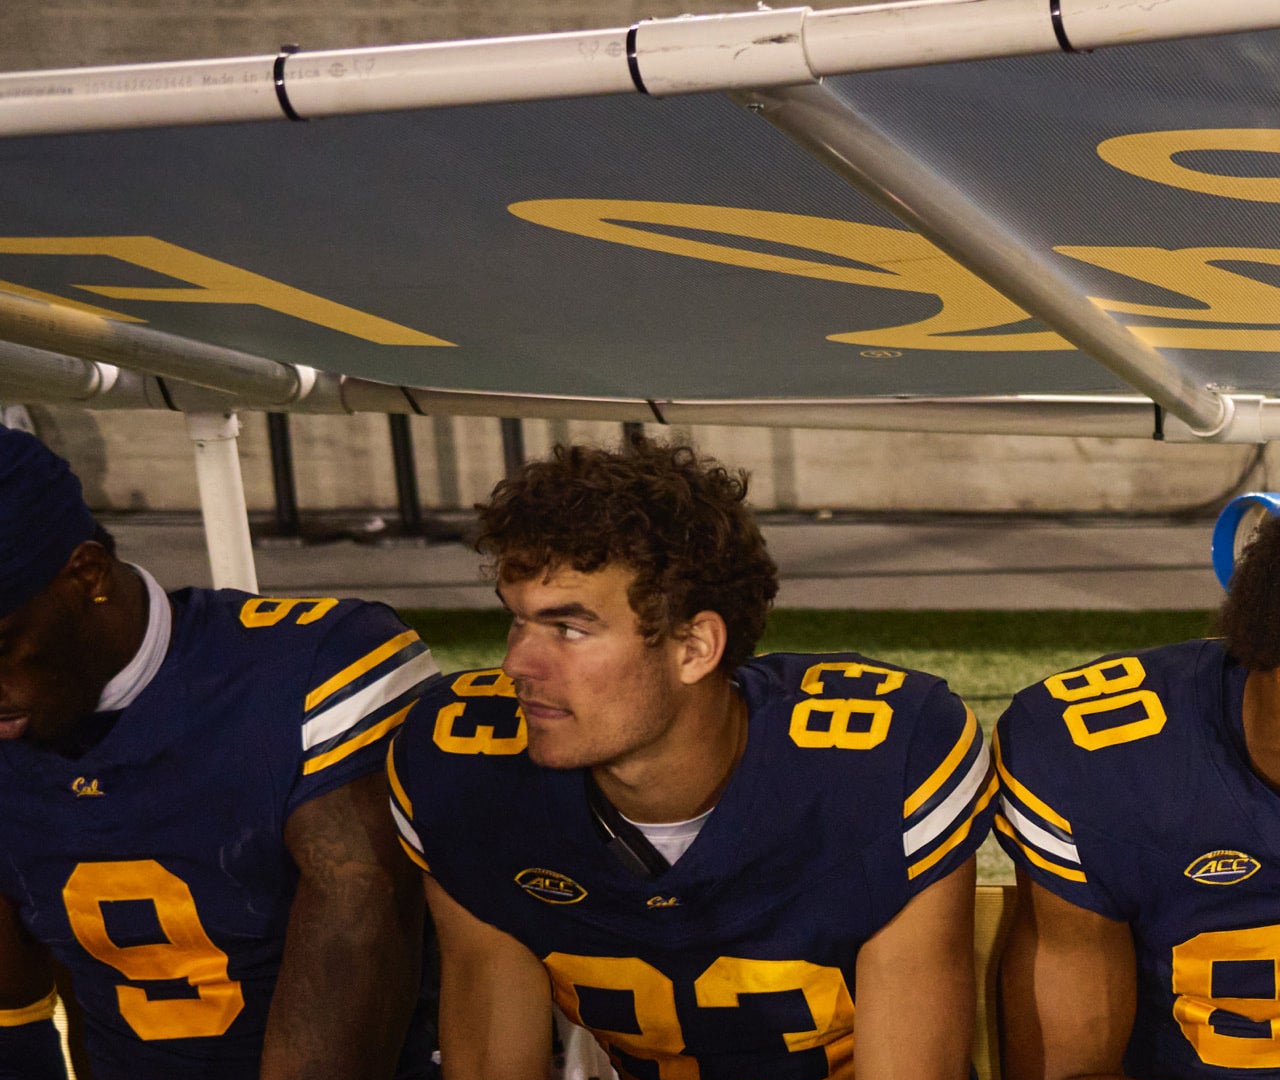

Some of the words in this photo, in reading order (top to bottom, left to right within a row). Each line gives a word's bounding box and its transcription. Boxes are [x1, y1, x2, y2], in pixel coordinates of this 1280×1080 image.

[433, 669, 529, 756] 83
[789, 662, 908, 750] 83
[1044, 656, 1168, 752] 80
[71, 776, 105, 797] Cal
[63, 860, 245, 1041] 9
